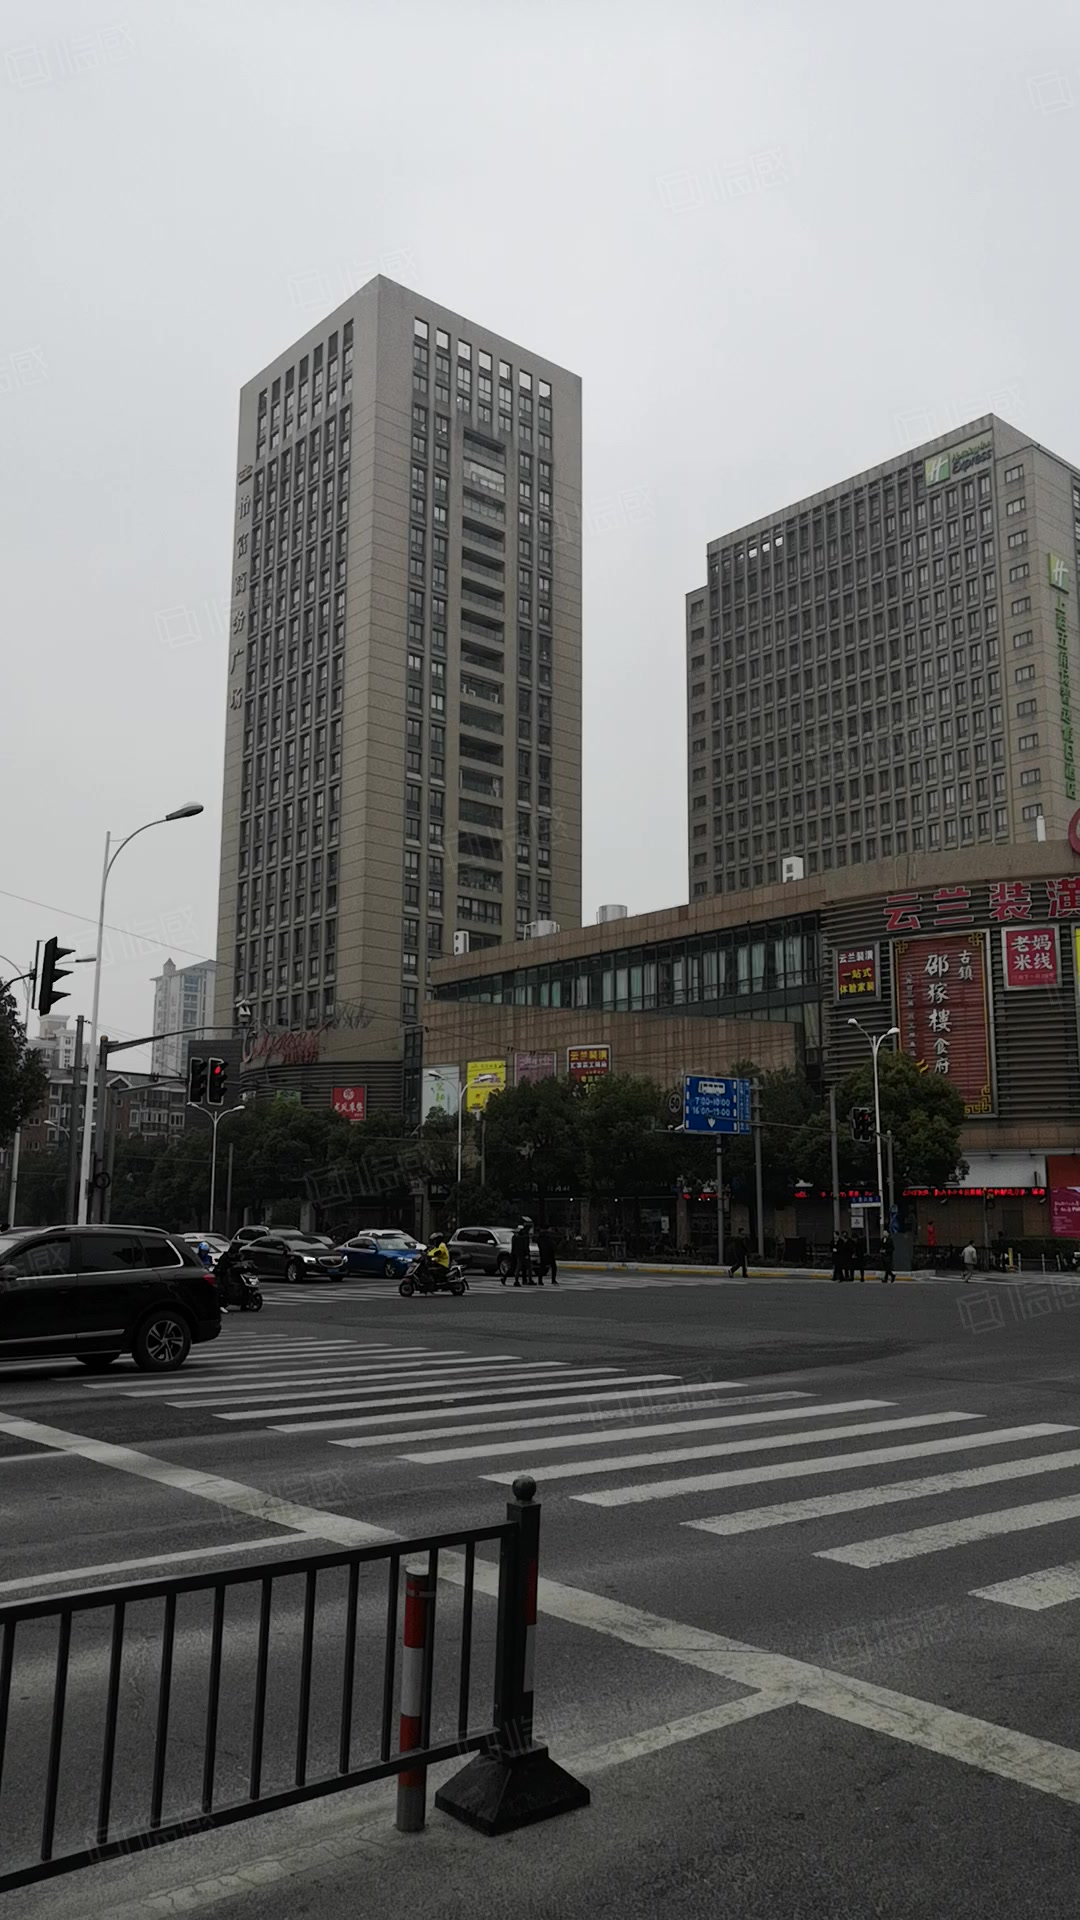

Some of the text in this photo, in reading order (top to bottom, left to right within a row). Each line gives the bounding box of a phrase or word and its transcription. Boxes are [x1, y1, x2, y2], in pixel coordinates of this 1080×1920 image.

[883, 877, 1080, 931] 云兰装潢
[1010, 934, 1052, 953] 老妈
[838, 949, 874, 964] 云兰装潢
[1013, 953, 1053, 971] 米线
[841, 967, 873, 980] 一站式
[839, 981, 875, 996] 体验家装
[669, 1094, 680, 1110] 50
